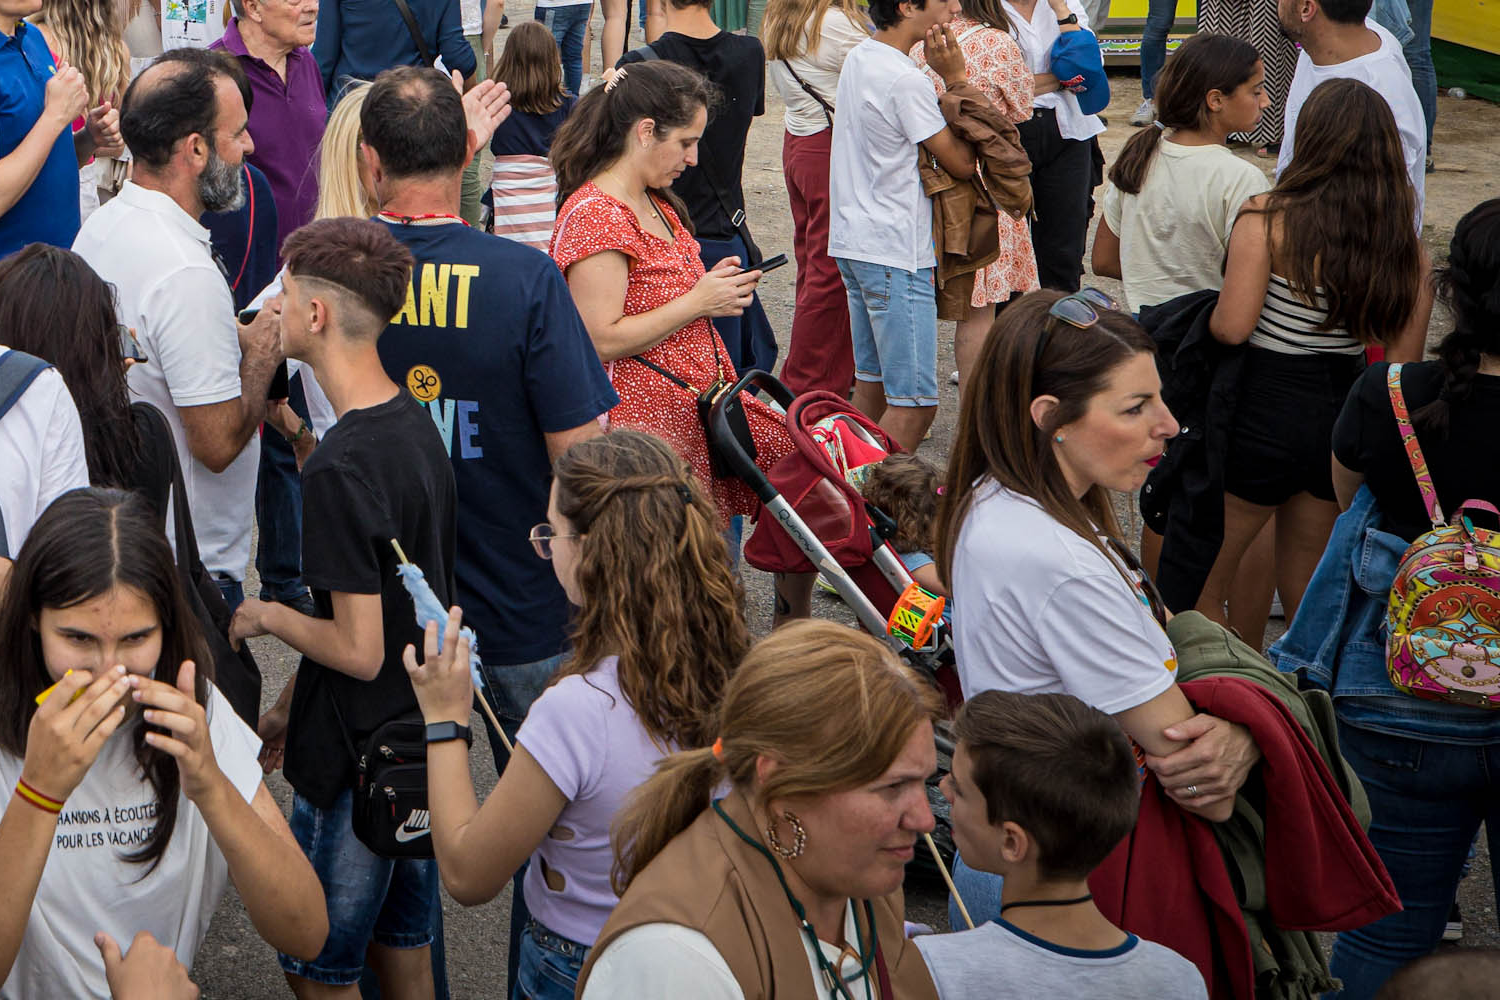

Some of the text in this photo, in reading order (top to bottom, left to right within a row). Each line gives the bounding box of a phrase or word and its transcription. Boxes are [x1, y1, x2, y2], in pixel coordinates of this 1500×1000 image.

[389, 263, 481, 329] ANT
[412, 396, 484, 460] VE
[778, 508, 814, 553] Quinny
[57, 807, 101, 825] HANSONS
[405, 809, 430, 829] NIK
[57, 834, 83, 849] POUR
[86, 832, 104, 848] LES
